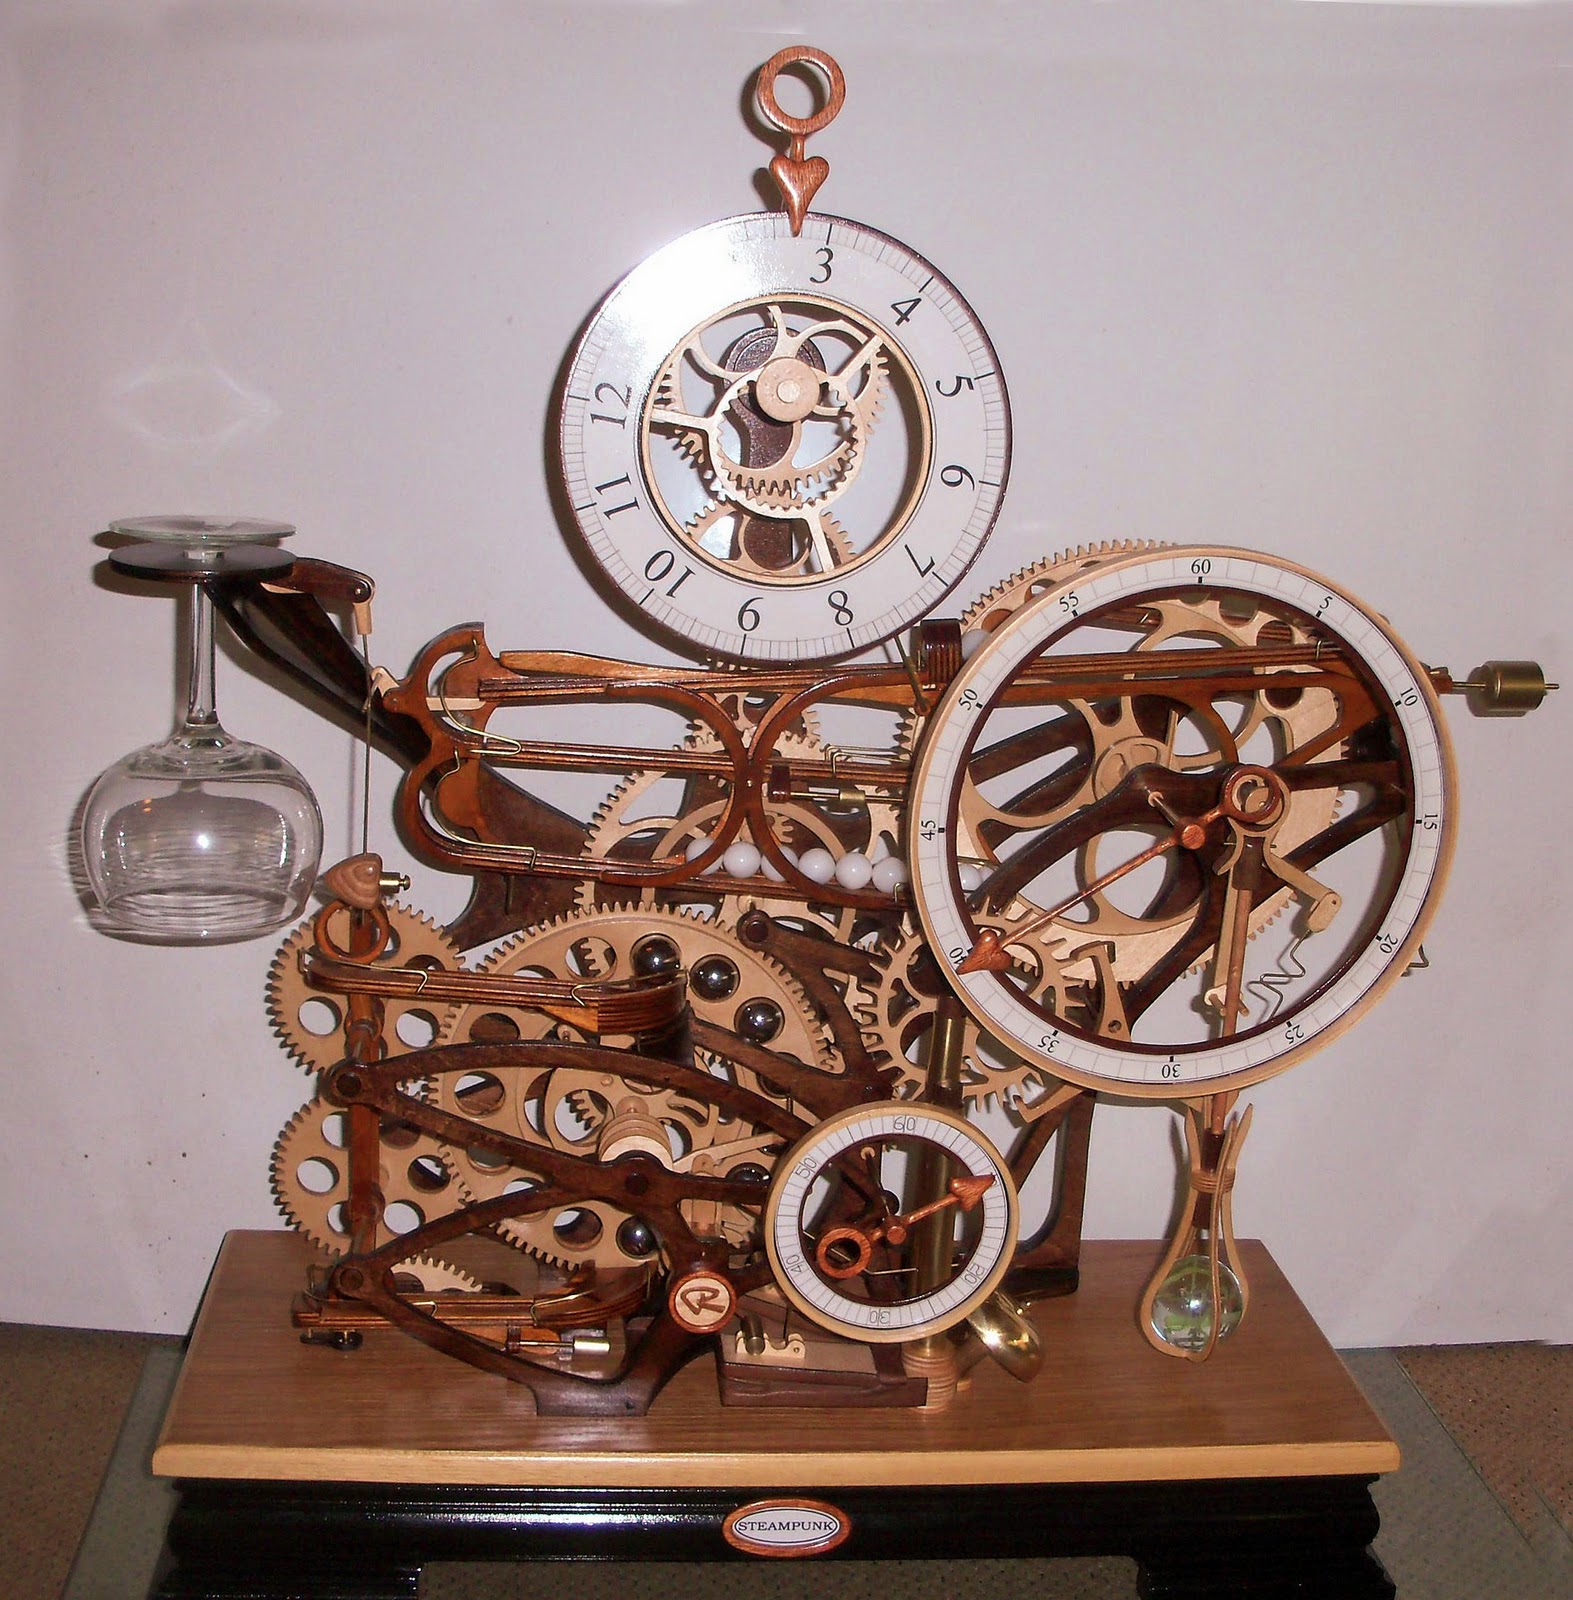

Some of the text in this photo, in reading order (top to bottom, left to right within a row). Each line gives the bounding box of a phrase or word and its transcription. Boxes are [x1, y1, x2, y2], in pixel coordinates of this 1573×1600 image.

[810, 247, 833, 284] 3
[890, 297, 923, 327] 4
[935, 375, 974, 398] 5
[590, 381, 632, 430] 12
[940, 464, 975, 491] 6
[595, 472, 642, 520] 11
[904, 543, 936, 578] 7
[1190, 558, 1212, 574] 60
[643, 549, 696, 599] 10
[827, 589, 853, 626] 8
[1059, 591, 1079, 613] 55
[1319, 595, 1333, 610] 5
[958, 688, 979, 711] 50
[1399, 686, 1418, 707] 10
[921, 819, 936, 841] 45
[1423, 812, 1437, 831] 15
[1379, 932, 1398, 954] 20
[1038, 1034, 1060, 1054] 35
[1285, 1024, 1305, 1044] 25
[1161, 1063, 1181, 1079] 30
[893, 1115, 916, 1132] 60
[795, 1156, 817, 1179] 50
[784, 1254, 803, 1273] 40
[962, 1264, 986, 1285] 20
[868, 1310, 891, 1324] 30
[738, 1521, 834, 1531] STEAMPUNK
